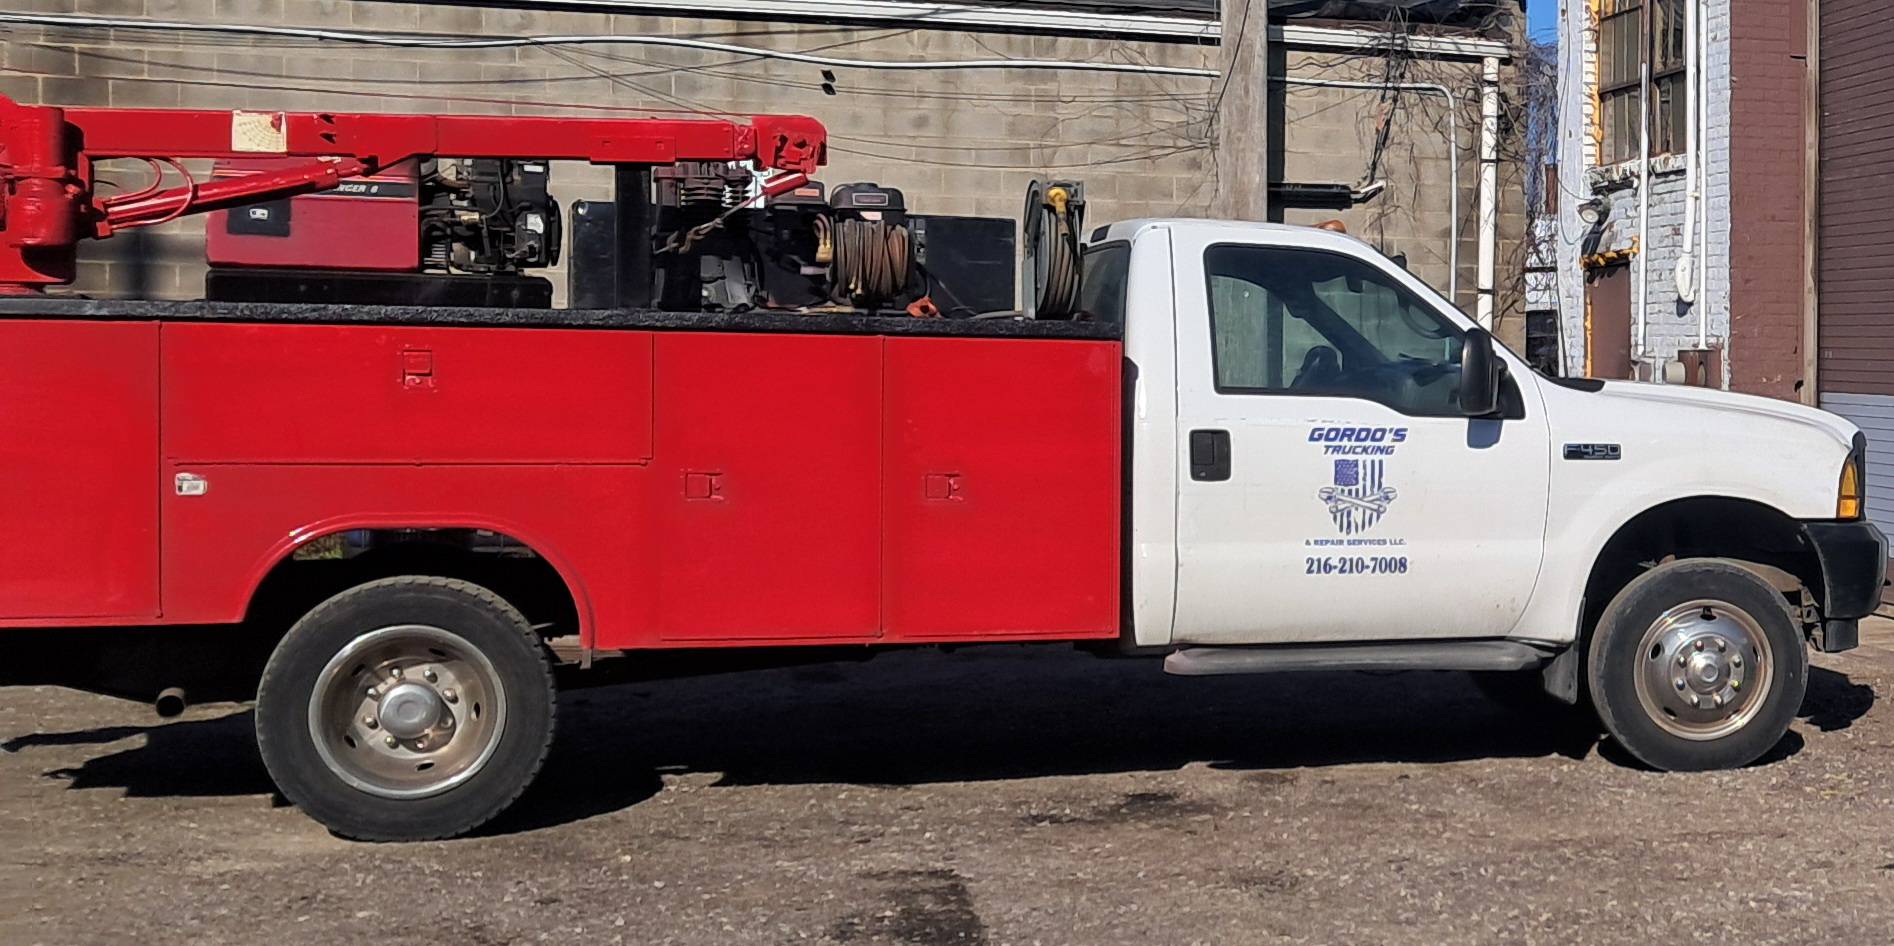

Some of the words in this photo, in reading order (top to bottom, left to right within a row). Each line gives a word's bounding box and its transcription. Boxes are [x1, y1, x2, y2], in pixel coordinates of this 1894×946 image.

[1308, 427, 1409, 443] GORDO'S
[1323, 445, 1395, 456] TRUCKING
[1313, 538, 1345, 546] REPAIR
[1346, 538, 1387, 546] SERVICES
[1305, 556, 1408, 575] 216-210-7008
